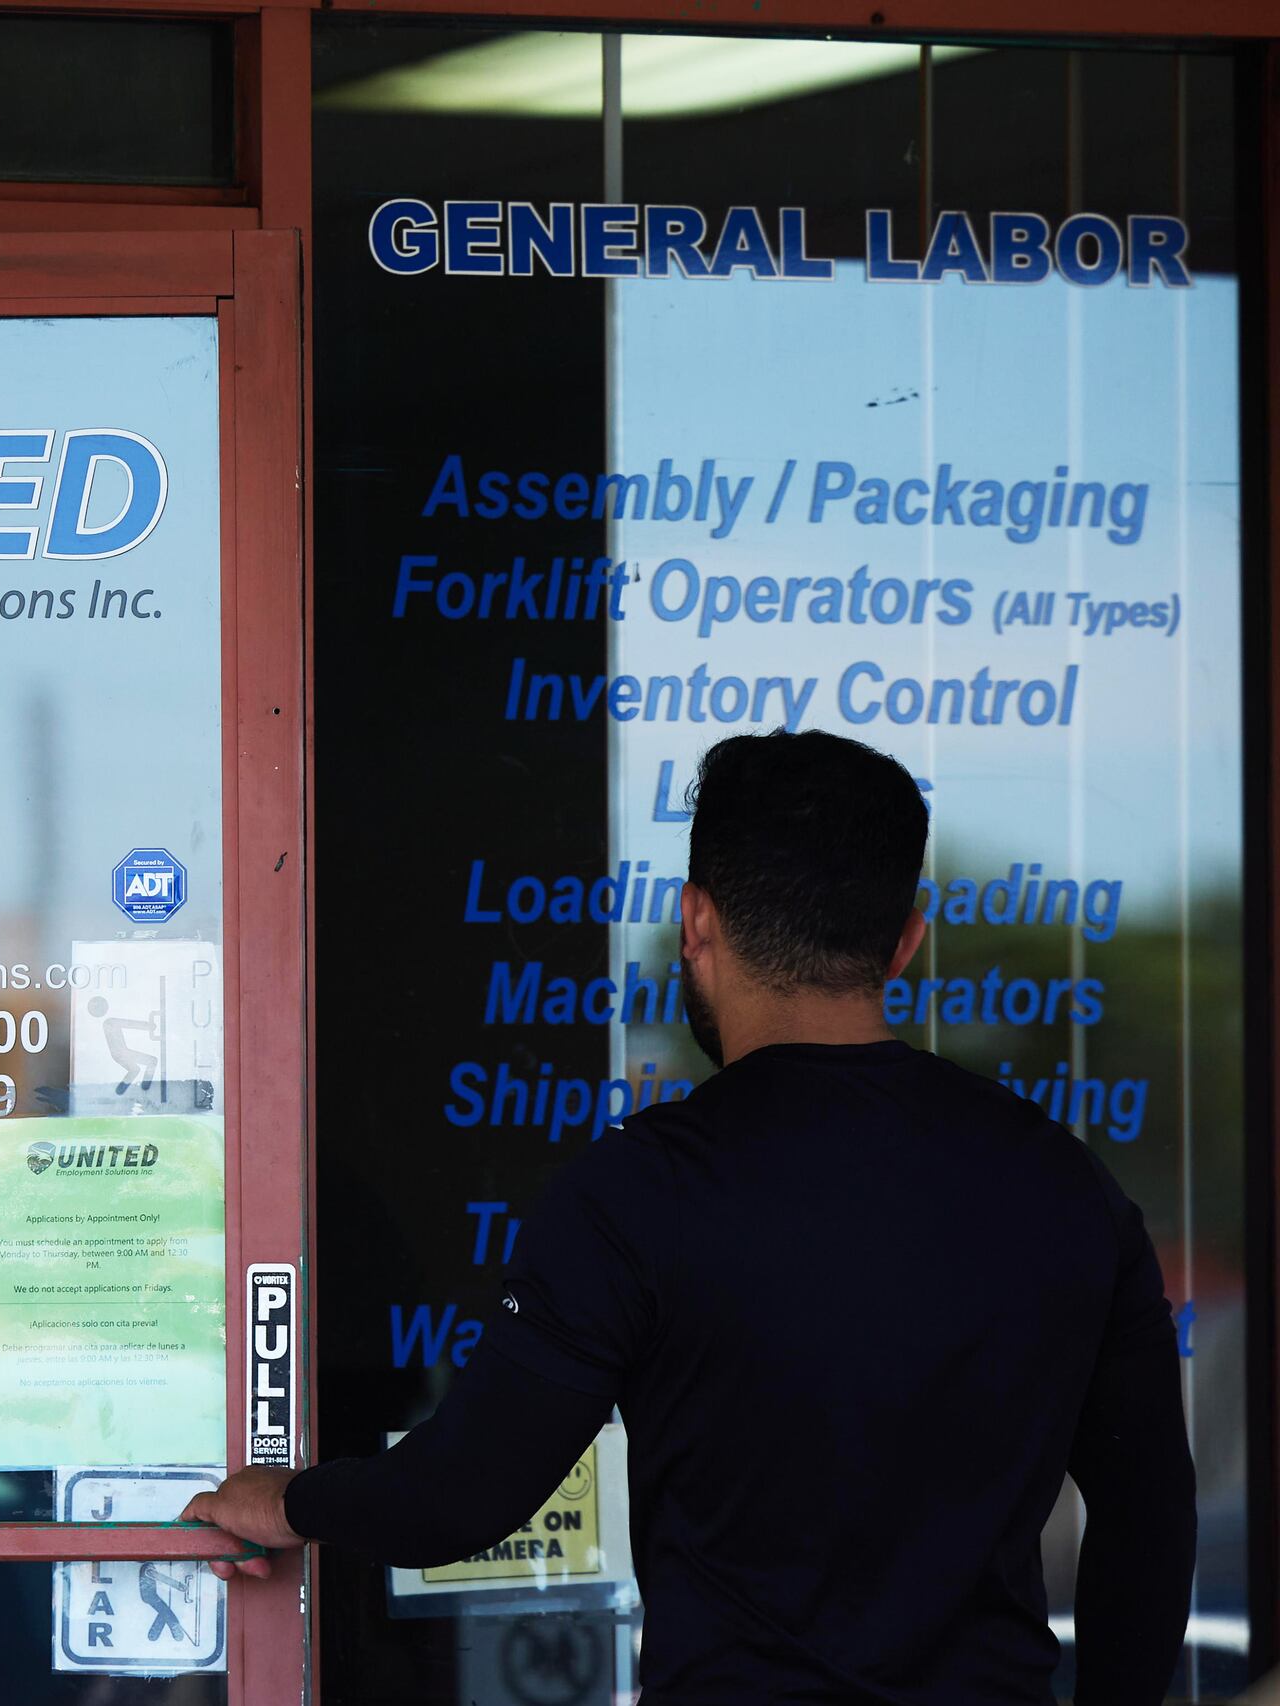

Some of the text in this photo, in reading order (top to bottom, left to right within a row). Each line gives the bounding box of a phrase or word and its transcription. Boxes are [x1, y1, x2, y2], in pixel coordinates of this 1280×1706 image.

[369, 199, 1195, 289] GENERAL LABOR
[423, 455, 1149, 545] Assembly / Packaging
[88, 579, 162, 619] Inc.
[393, 556, 1181, 638] Forklift Operators (All Types)
[505, 659, 1079, 735] Inventory Control
[157, 859, 165, 867] by
[126, 872, 173, 897] ADT
[464, 861, 685, 924] Loadin
[484, 962, 1105, 1025] Machi erators
[57, 1143, 160, 1169] UNITED
[56, 1169, 103, 1177] Employment
[105, 1168, 139, 1176] Solutions
[26, 1213, 161, 1225] Applications by Appointment Only!
[15, 1239, 35, 1247] must
[36, 1238, 71, 1247] schedule
[84, 1238, 134, 1247] appointment
[136, 1238, 145, 1246] to
[146, 1237, 168, 1247] apply
[169, 1237, 188, 1245] from
[81, 1249, 115, 1258] between
[117, 1249, 133, 1257] 9:00
[135, 1249, 149, 1257] AM
[150, 1249, 165, 1257] and
[167, 1249, 188, 1257] 12:30
[261, 1275, 288, 1285] VORTEX
[13, 1285, 27, 1293] We
[28, 1285, 40, 1293] do
[56, 1285, 82, 1294] accept
[84, 1284, 130, 1294] applications
[81, 1319, 98, 1328] solo
[100, 1320, 115, 1328] con
[116, 1319, 131, 1328] cita
[132, 1319, 159, 1329] previa!
[84, 1343, 99, 1351] cita
[100, 1344, 118, 1352] para
[119, 1342, 145, 1352] aplicar
[146, 1342, 157, 1351] de
[158, 1342, 181, 1351] lunes
[98, 1354, 112, 1362] AM
[255, 1286, 288, 1435] PULL
[253, 1437, 288, 1447] DOOR
[253, 1447, 288, 1455] SERVICE
[543, 1510, 582, 1532] ON
[87, 1496, 115, 1647] JLAR
